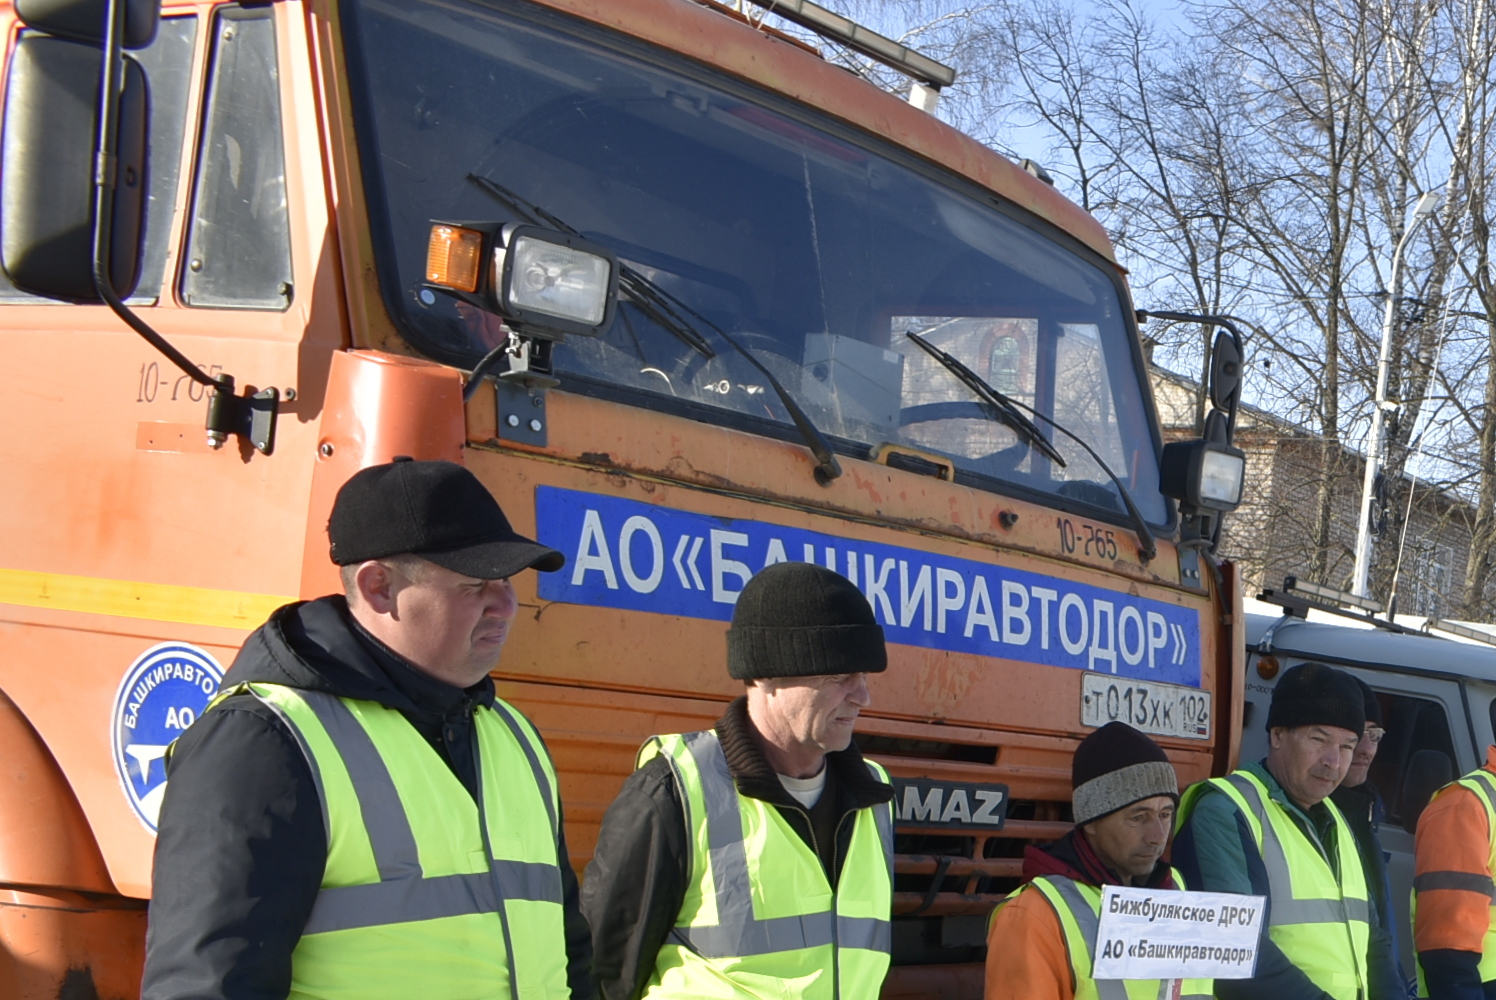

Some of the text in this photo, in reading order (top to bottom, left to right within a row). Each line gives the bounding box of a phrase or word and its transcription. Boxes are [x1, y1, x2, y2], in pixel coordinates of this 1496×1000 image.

[1057, 517, 1117, 560] 10-765
[125, 662, 218, 729] БАШКИРАВТО
[1179, 695, 1206, 723] 102
[165, 706, 195, 729] АО
[1183, 722, 1197, 733] RUS
[896, 786, 1003, 824] MAZ
[1109, 893, 1256, 928] Бижбулякское ДРСУ
[1102, 939, 1253, 965] АО «Башкиравтодор»
